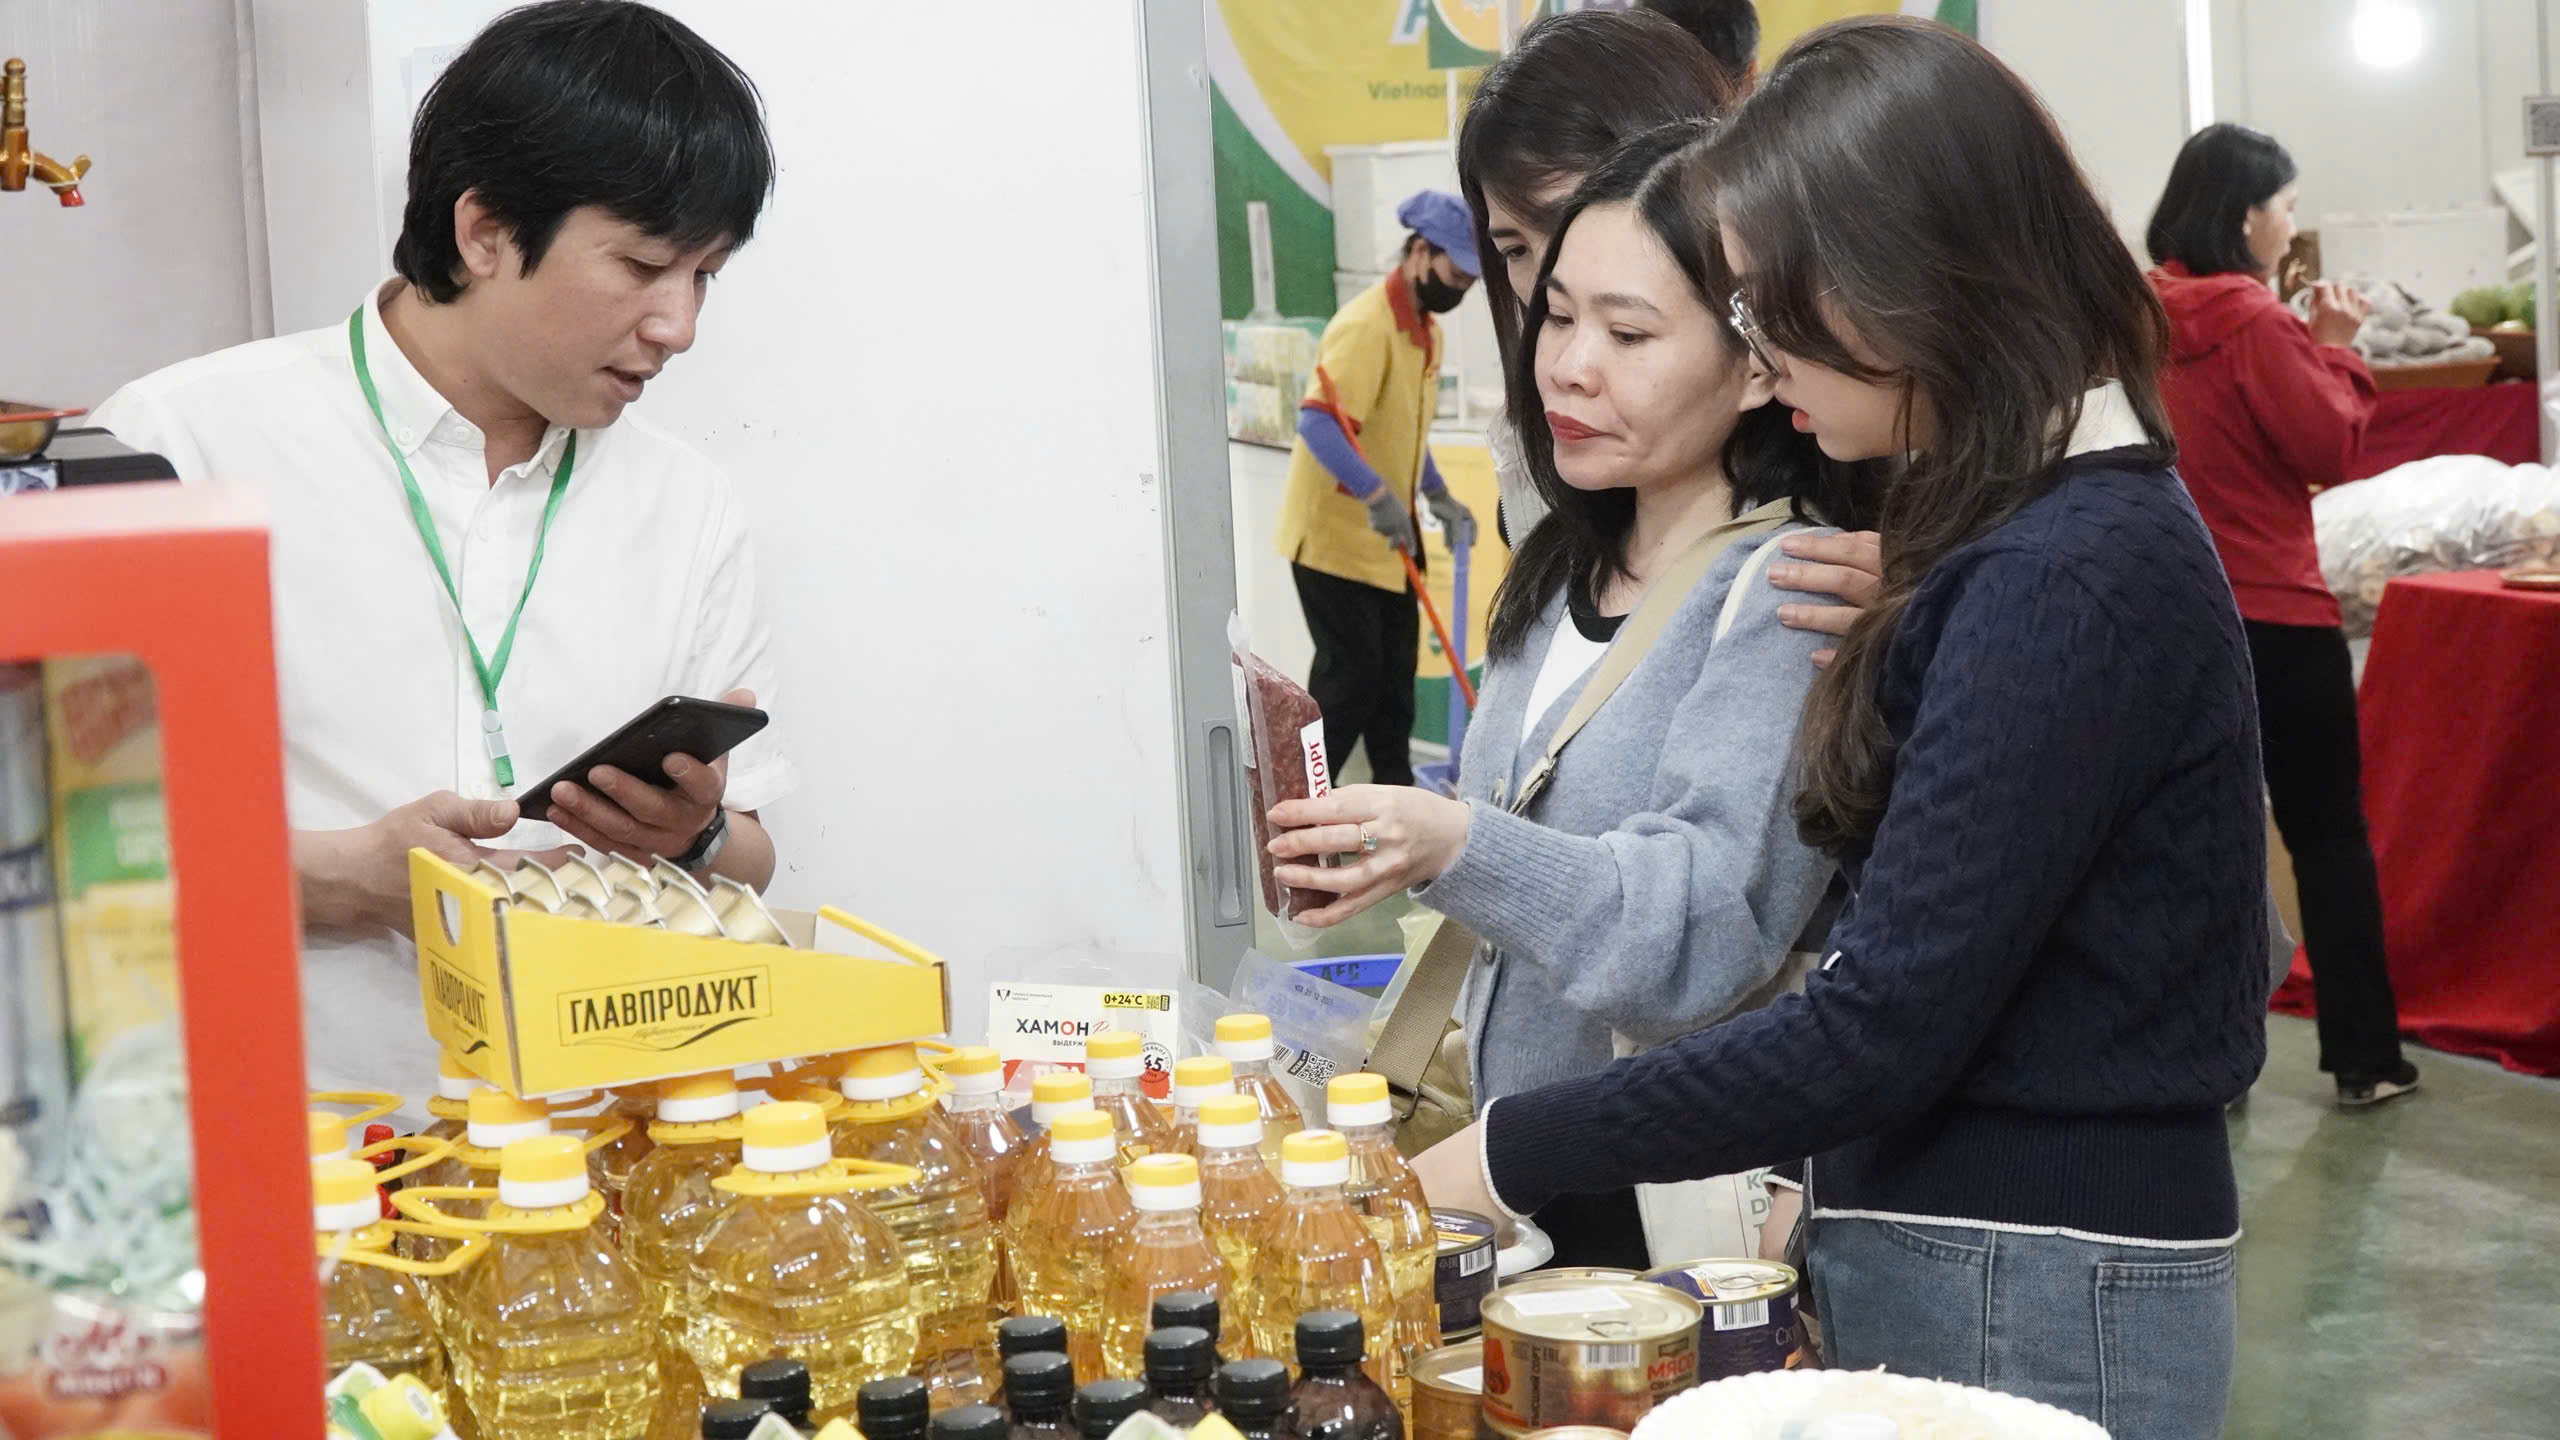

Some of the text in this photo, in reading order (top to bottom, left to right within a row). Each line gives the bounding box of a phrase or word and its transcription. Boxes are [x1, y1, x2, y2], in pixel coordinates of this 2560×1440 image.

[569, 975, 759, 1034] ГЛАВПРОДУКТ
[1016, 1018, 1089, 1036] ХАМОН
[1144, 1054, 1164, 1072] 45
